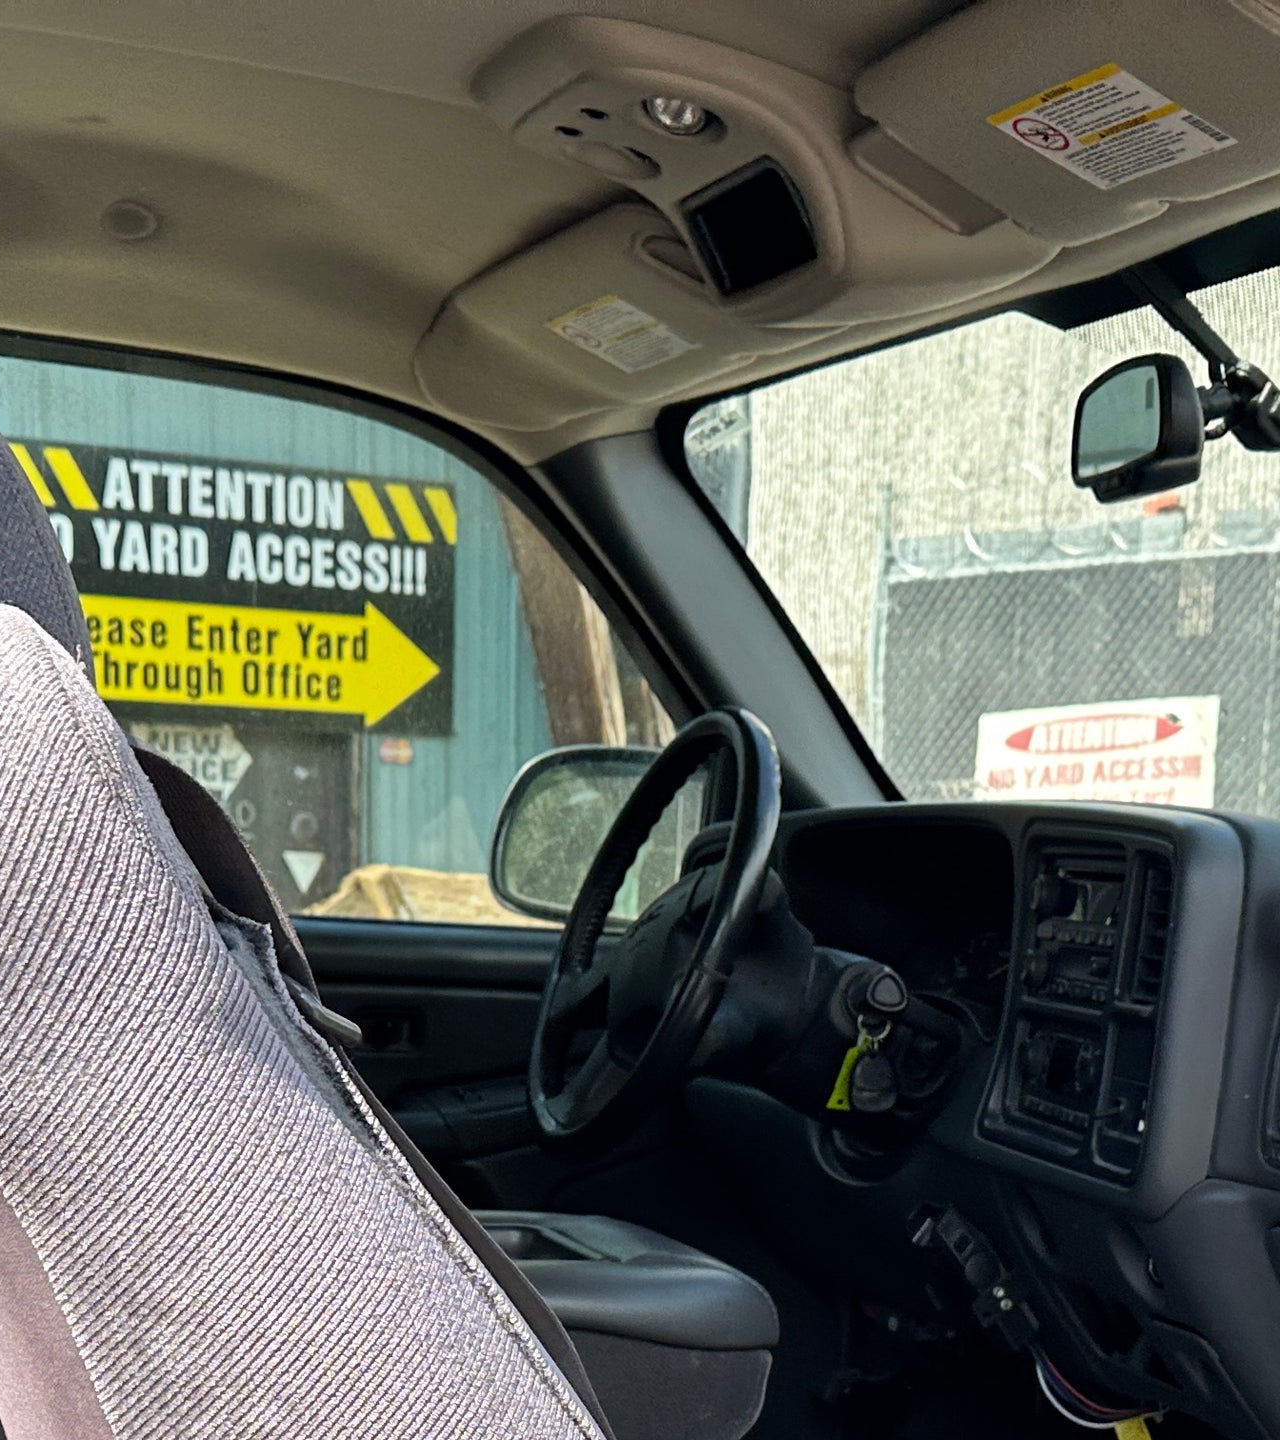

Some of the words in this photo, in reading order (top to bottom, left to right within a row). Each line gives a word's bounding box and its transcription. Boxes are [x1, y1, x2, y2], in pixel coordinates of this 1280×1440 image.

[102, 456, 345, 531] ATTENTION
[49, 512, 74, 566] O
[91, 517, 209, 578] YARD
[227, 529, 427, 596] ACCESS!!!
[86, 615, 168, 649] ease
[187, 614, 280, 656] Enter
[297, 621, 368, 662] Yard
[93, 651, 223, 699] hrough
[243, 660, 342, 701] Office
[1025, 762, 1084, 789] YARD
